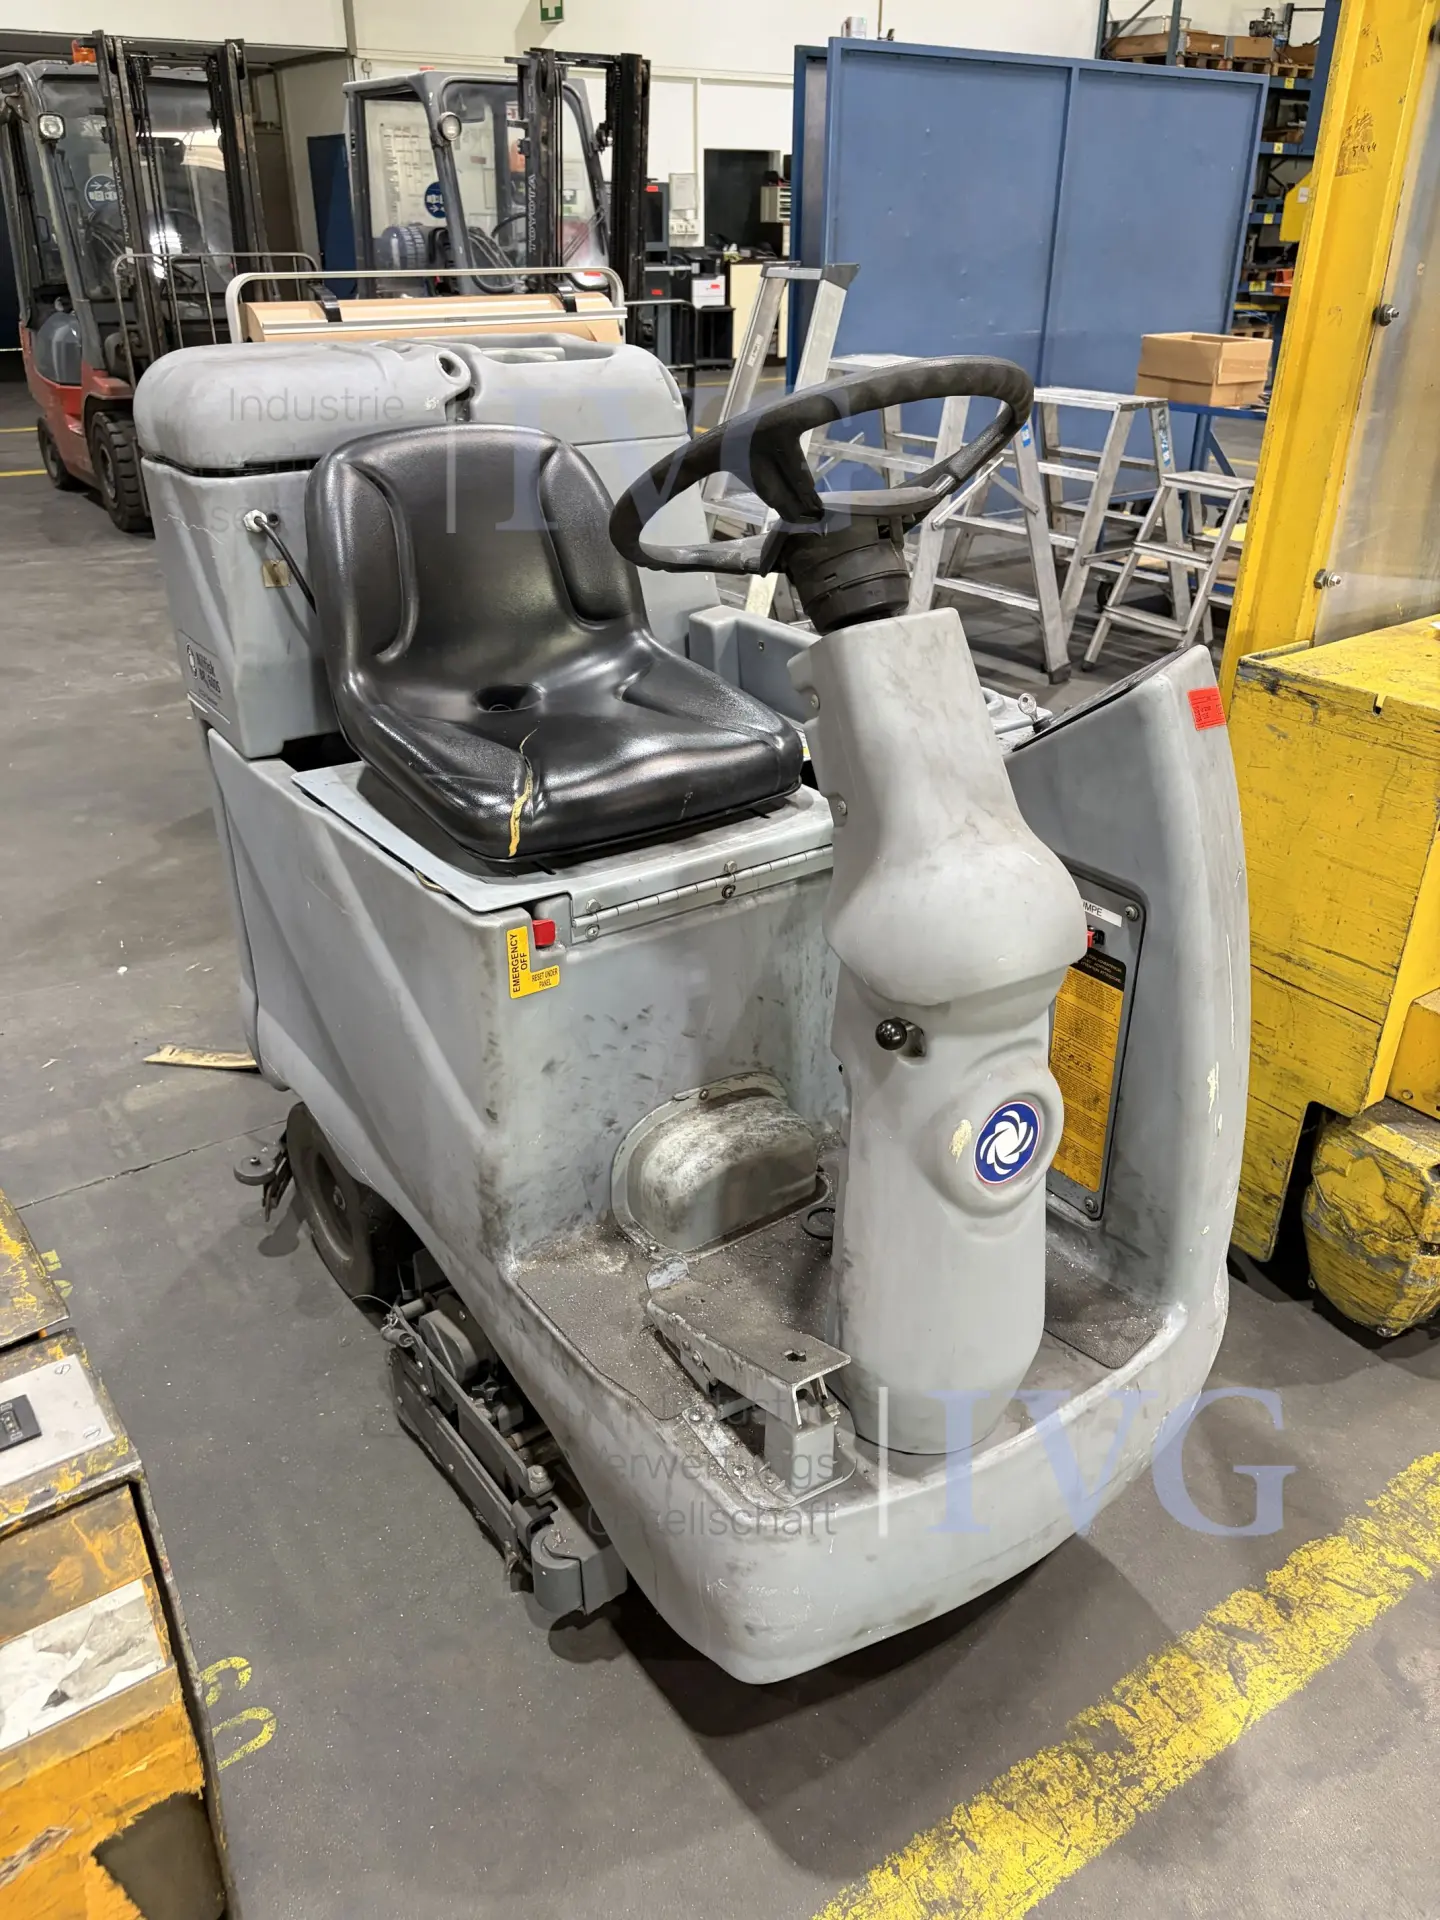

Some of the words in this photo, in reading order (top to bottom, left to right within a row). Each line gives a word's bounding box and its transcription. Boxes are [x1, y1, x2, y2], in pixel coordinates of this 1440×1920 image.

[528, 173, 537, 253] TOYOTA
[510, 934, 520, 993] EMERGENCY
[532, 971, 545, 982] RESET
[545, 967, 558, 979] UNDER
